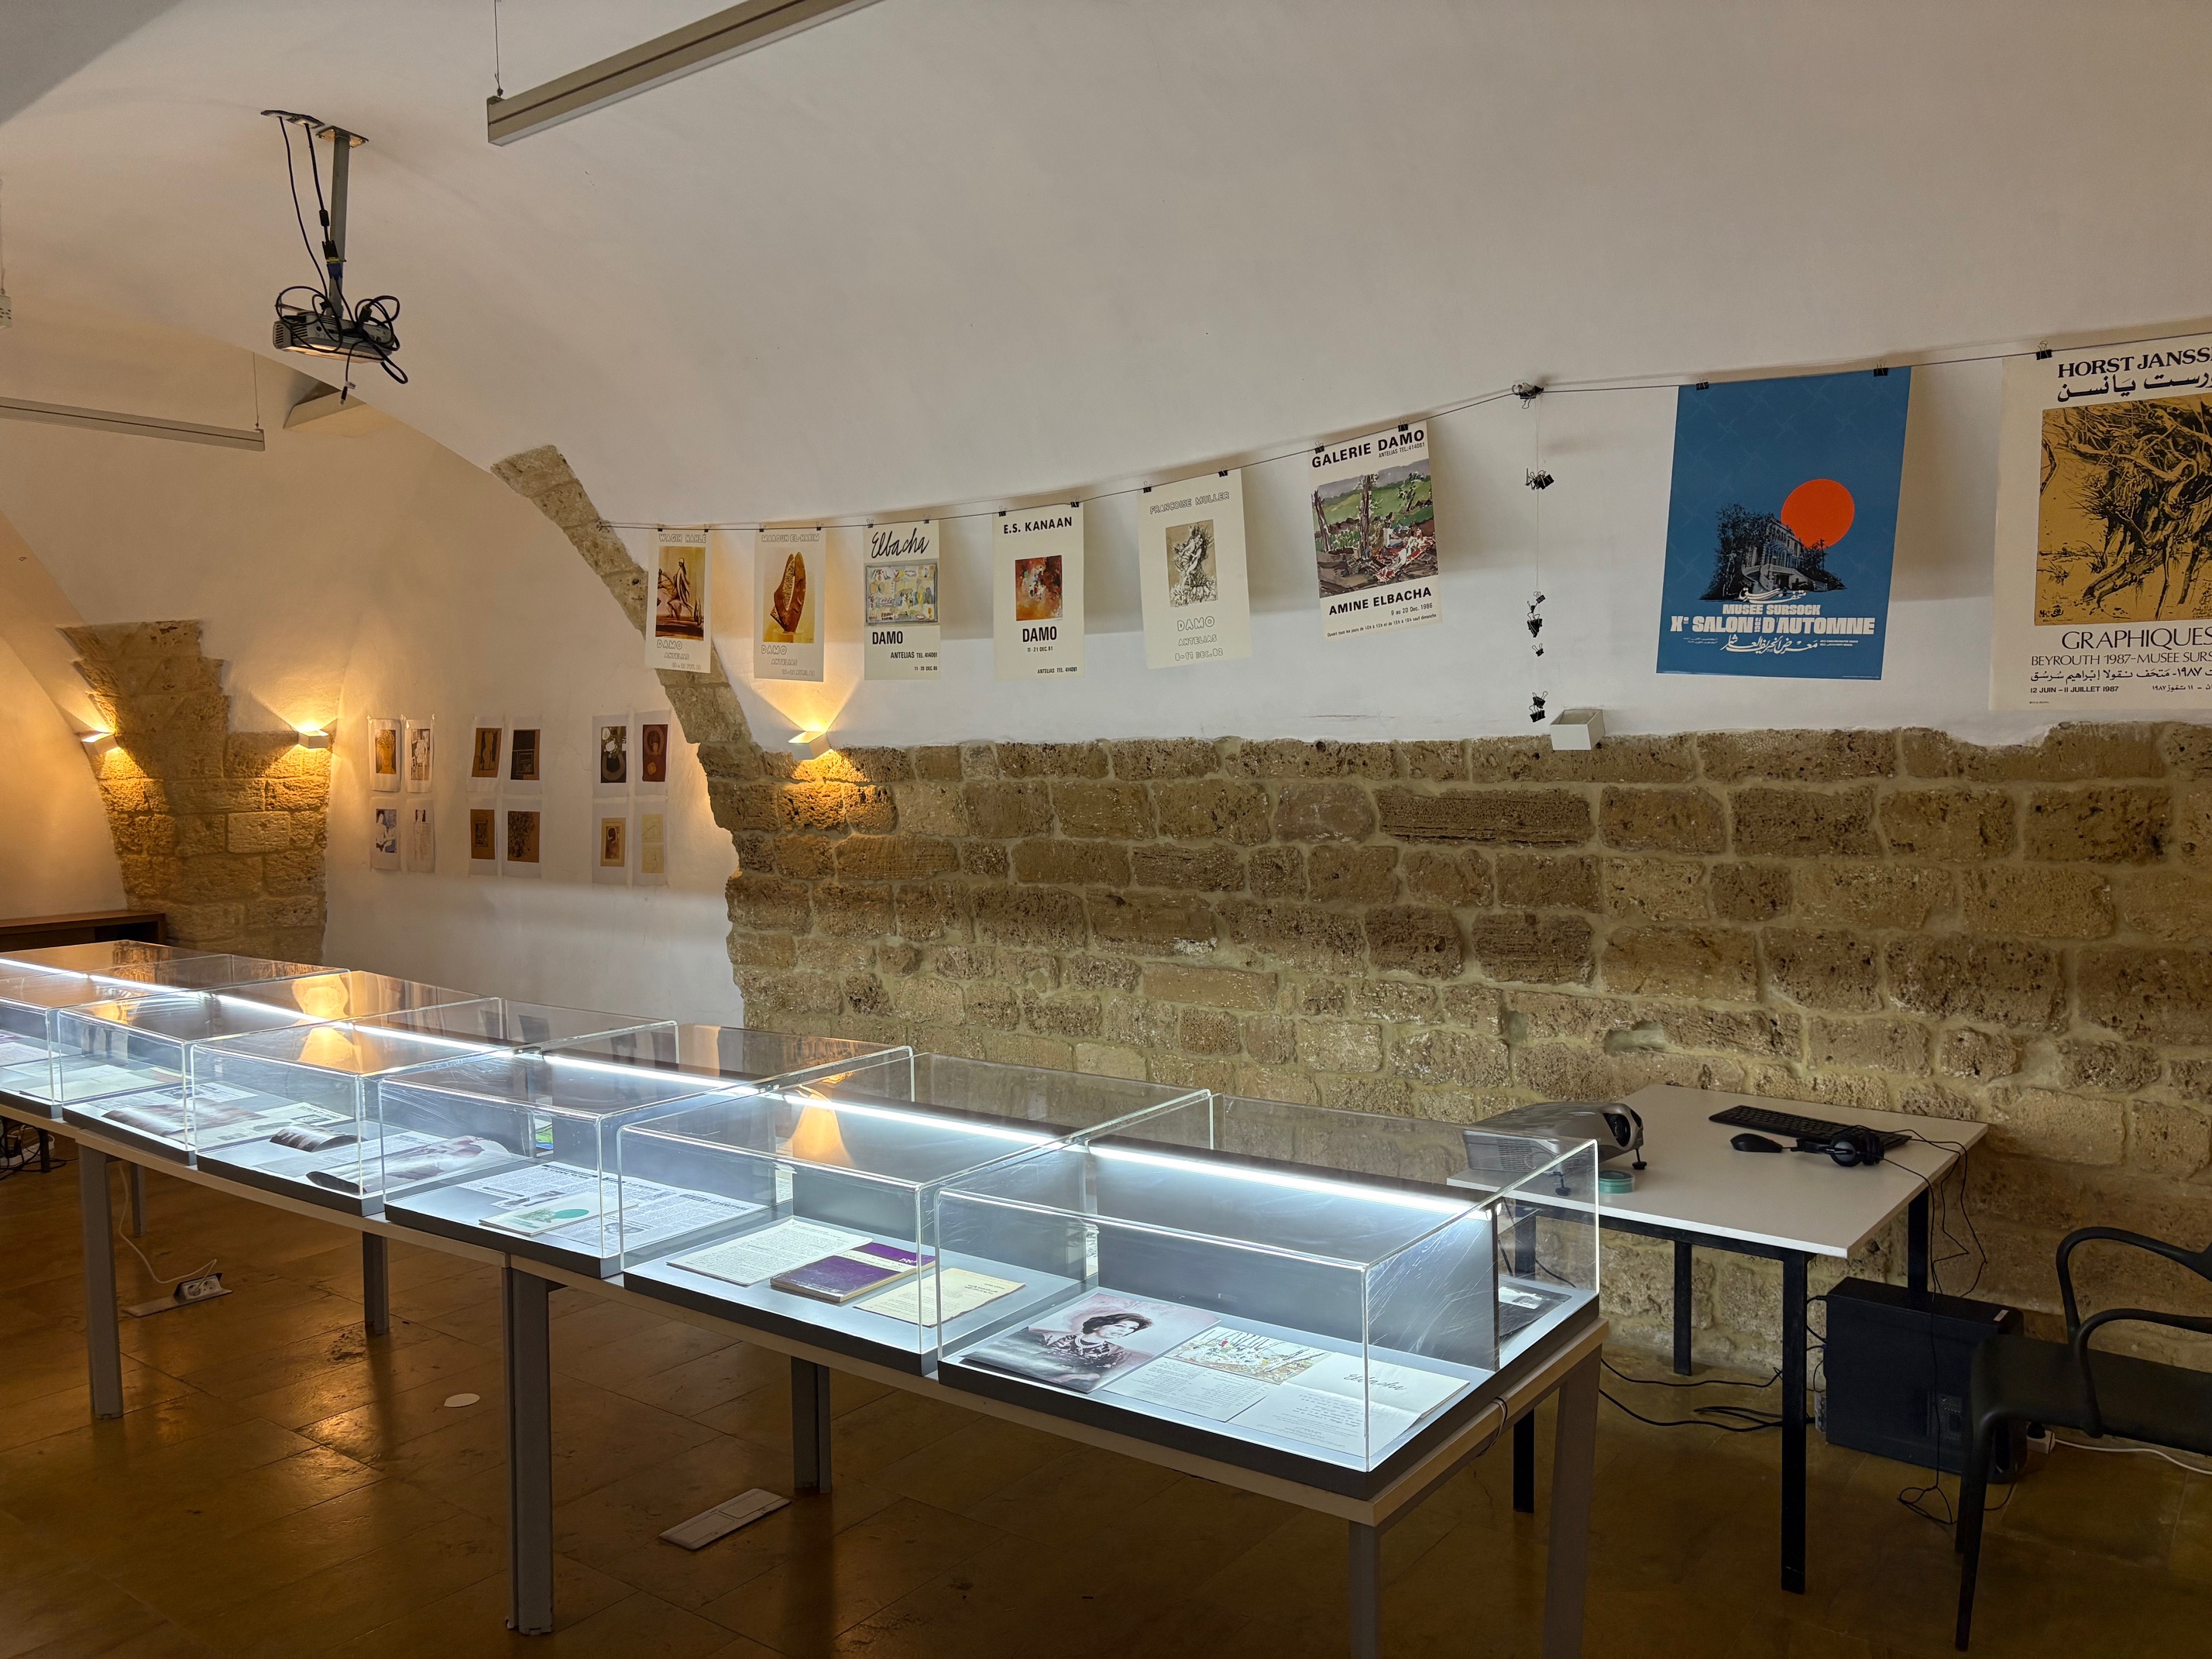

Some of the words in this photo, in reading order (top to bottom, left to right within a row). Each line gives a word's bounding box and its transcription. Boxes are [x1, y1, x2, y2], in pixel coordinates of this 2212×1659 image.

[2058, 356, 2135, 379] HORST
[2137, 347, 2212, 370] JANSS
[1311, 442, 1372, 468] GALERIE
[1378, 430, 1424, 452] DAMO
[1379, 448, 1398, 458] ANTELIAS
[1150, 498, 1192, 514] FRANÇOISE
[1195, 491, 1229, 506] MULLER
[1004, 523, 1021, 534] E.S.
[1025, 517, 1072, 532] KANAAN
[871, 527, 929, 558] Elbacha
[1329, 599, 1369, 616] AMINE
[1373, 587, 1431, 607] ELBACHA
[1723, 604, 1764, 614] MUSEE
[1767, 605, 1821, 615] SURSOCK
[1177, 616, 1214, 631] DAMO
[1692, 616, 1753, 633] SALON
[1762, 617, 1875, 634] D'AUTOMNE
[872, 631, 903, 644] DAMO
[1022, 626, 1057, 642] DAMO
[1178, 634, 1217, 646] ANTELIAS
[2062, 627, 2212, 651] GRAPHIQUES
[657, 639, 682, 650] DAMO
[761, 644, 787, 654] DAMO
[2032, 655, 2100, 665] BEYROUTH
